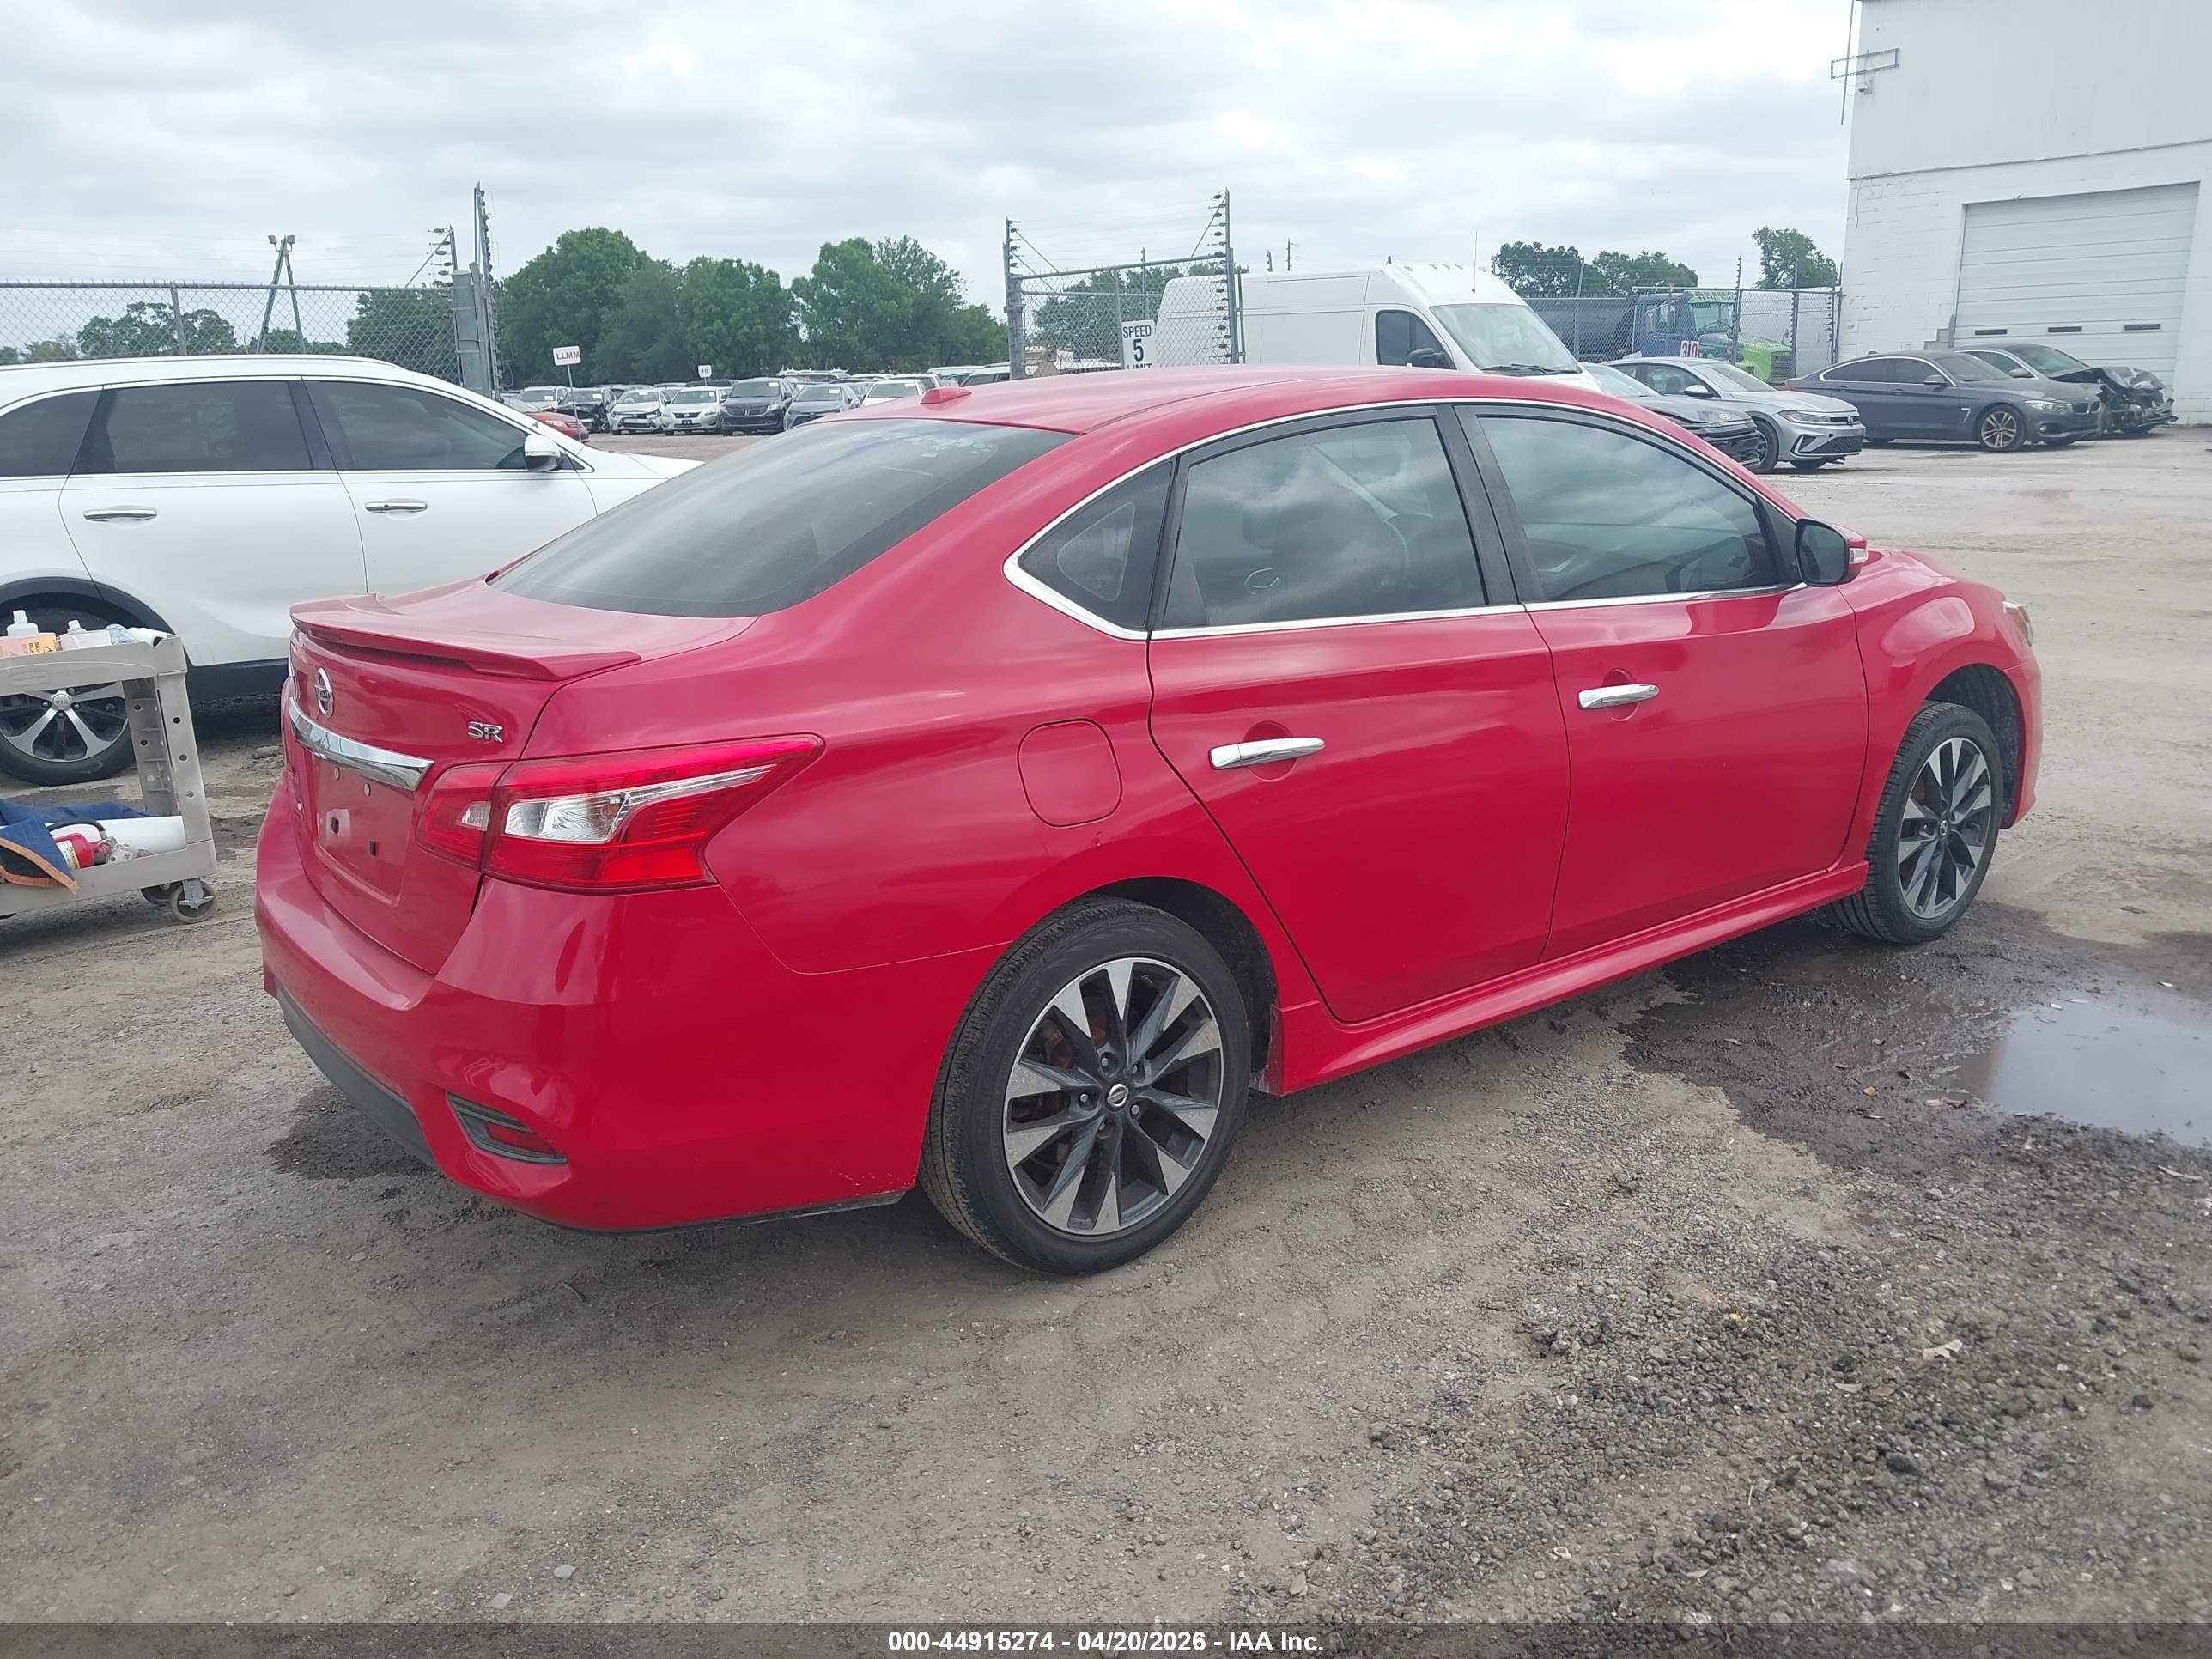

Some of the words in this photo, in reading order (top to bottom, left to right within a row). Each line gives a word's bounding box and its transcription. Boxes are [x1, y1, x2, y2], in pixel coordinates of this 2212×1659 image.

[1122, 325, 1152, 338] SPEED
[1133, 338, 1144, 362] 5
[467, 721, 503, 743] SR
